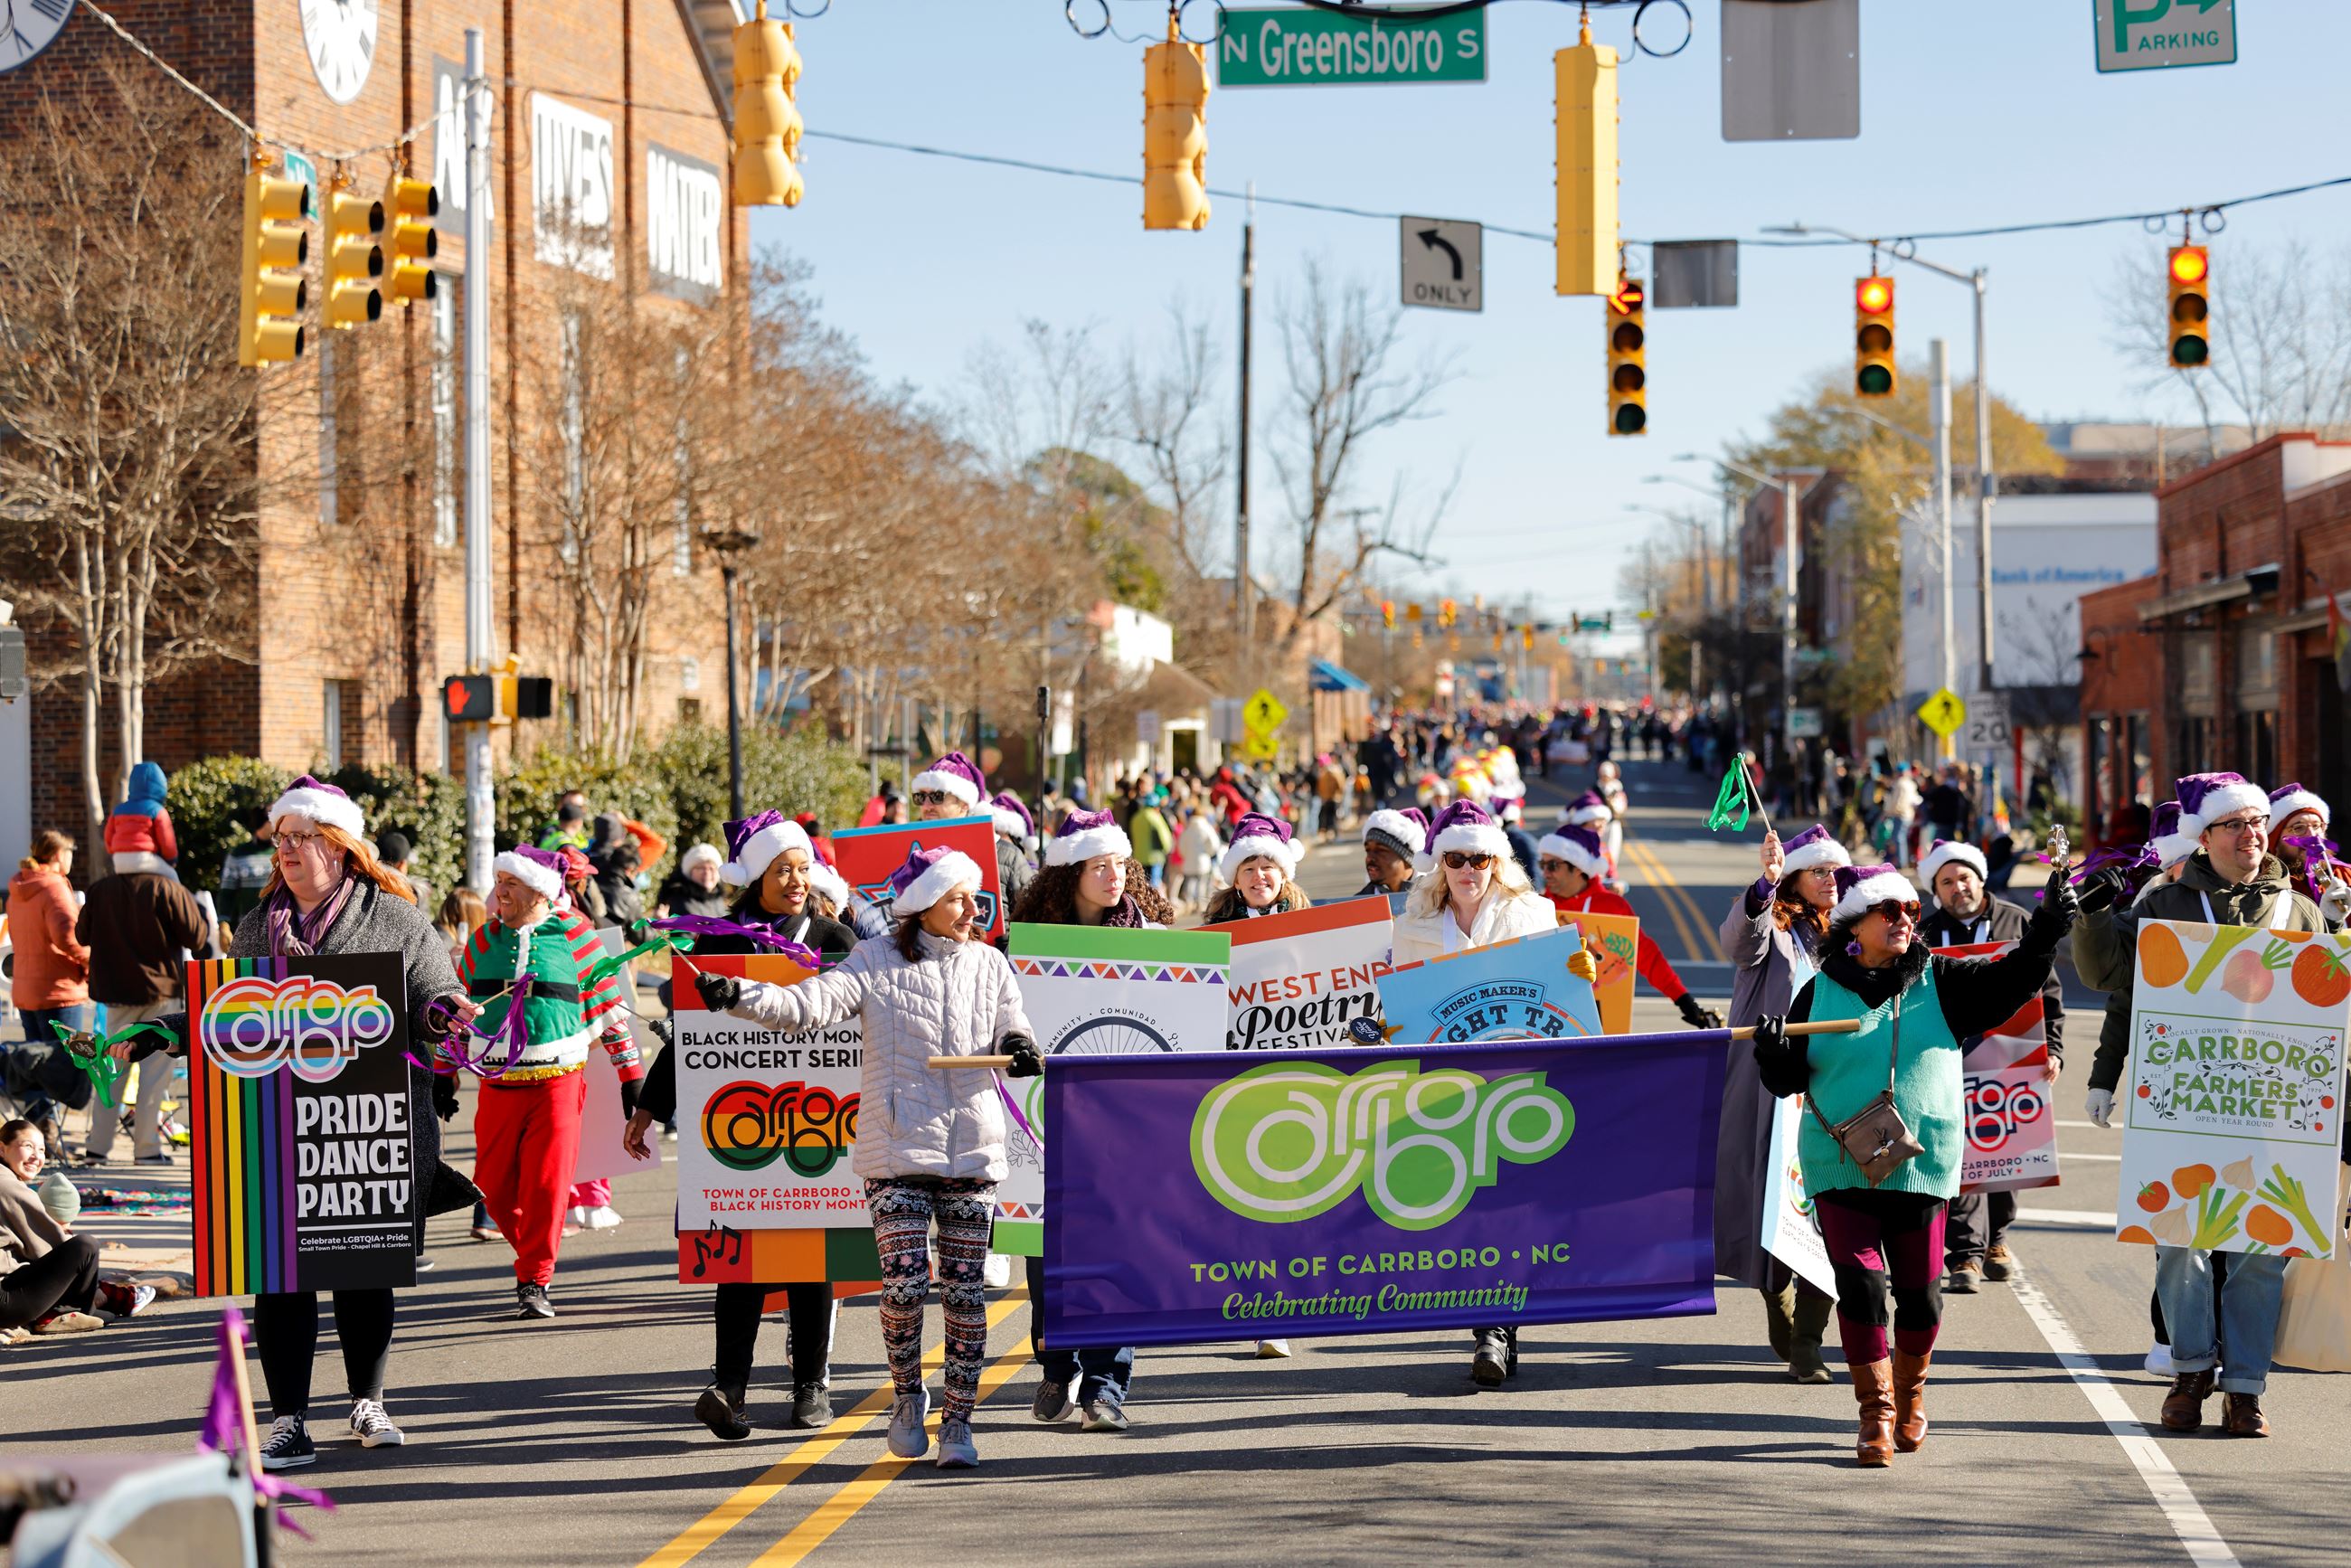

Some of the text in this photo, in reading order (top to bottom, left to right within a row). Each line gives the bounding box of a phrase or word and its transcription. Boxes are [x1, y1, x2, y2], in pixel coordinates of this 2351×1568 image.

[1224, 18, 1479, 77] N Greensboro S
[1413, 282, 1473, 305] ONLY
[1972, 723, 2005, 742] 20
[1229, 971, 1321, 1007] WEST
[1440, 986, 1537, 1019] MUSIC MAKER'S
[1043, 1007, 1157, 1054] OMMUNITY COMUNIDAD
[1236, 991, 1383, 1050] Poetry
[1440, 1005, 1508, 1044] GHT
[682, 1029, 863, 1046] BLACK HISTORY MON
[1257, 1027, 1349, 1050] FESTIVA
[2166, 1029, 2198, 1039] LOCALLY
[2237, 1028, 2286, 1041] NATIONALLY
[2287, 1036, 2315, 1051] KNOWN
[685, 1048, 863, 1070] CONCERT SERI
[2148, 1035, 2330, 1078] CARRBORO
[296, 1092, 408, 1136] PRIDE
[2170, 1091, 2299, 1120] MARKET
[2195, 1116, 2274, 1129] OPEN YEAR ROUND
[297, 1138, 410, 1177] DANCE
[1962, 1155, 2048, 1170] CARRBORO NC
[1968, 1171, 1983, 1179] OF
[1987, 1167, 2013, 1177] JULY
[297, 1179, 410, 1218] PARTY
[703, 1187, 851, 1199] TOWN OF CARRBORO
[710, 1199, 866, 1212] BLACK HISTORY MONT
[300, 1233, 409, 1245] Celebrate LGBTQIA+ Pride
[1190, 1242, 1571, 1282] TOWN OF CARRBORO NC
[1223, 1279, 1529, 1321] Celebrating Community
